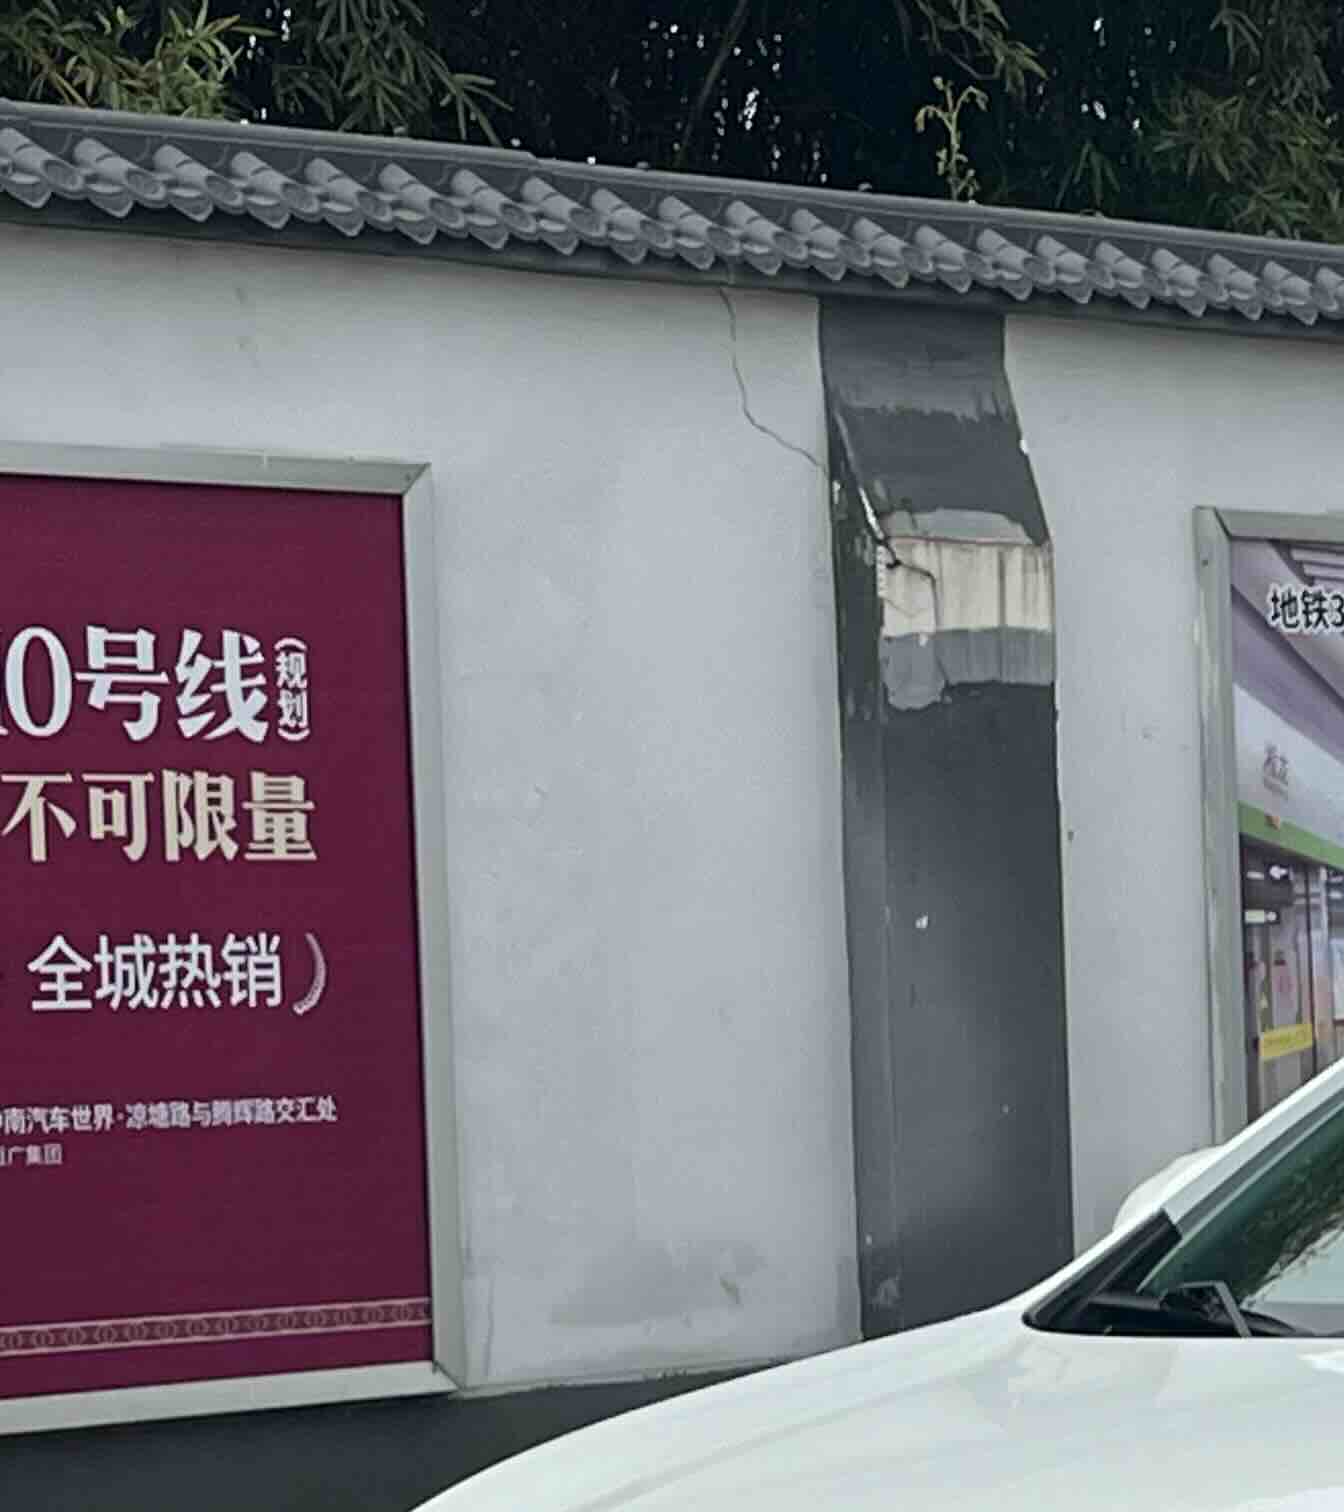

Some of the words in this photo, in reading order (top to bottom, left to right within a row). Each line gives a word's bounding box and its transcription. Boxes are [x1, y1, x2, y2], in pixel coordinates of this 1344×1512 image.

[0, 625, 269, 743] 0号线
[0, 768, 318, 862] 不可限量
[27, 931, 283, 1011] 全城热销
